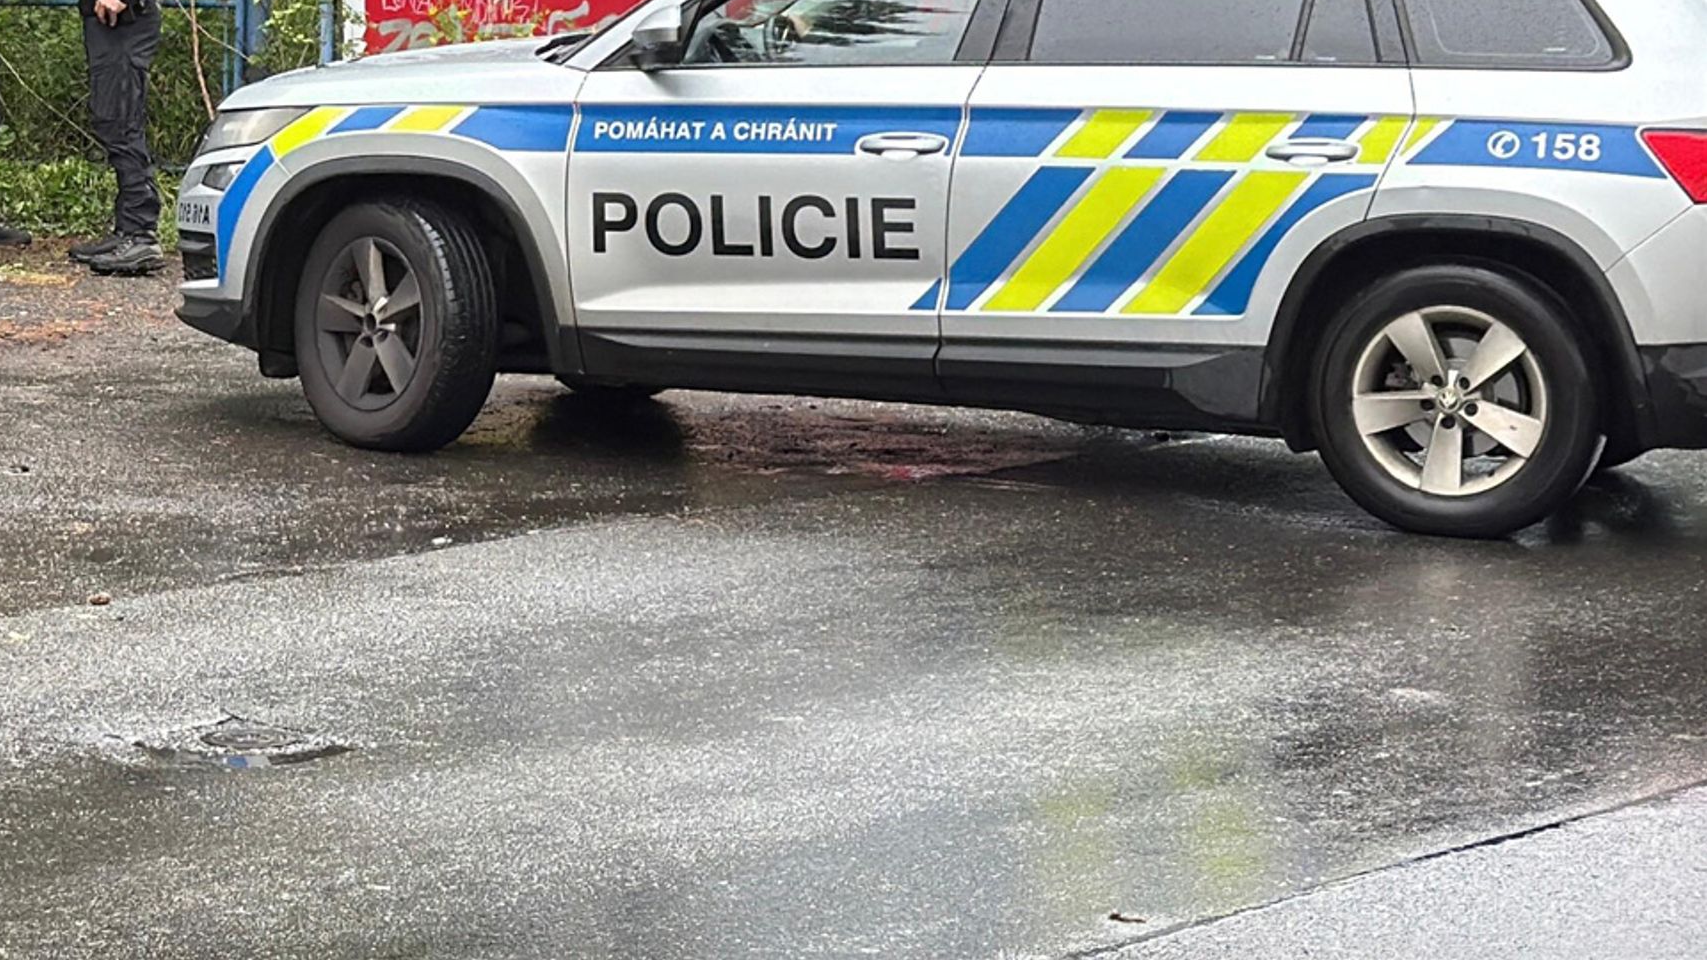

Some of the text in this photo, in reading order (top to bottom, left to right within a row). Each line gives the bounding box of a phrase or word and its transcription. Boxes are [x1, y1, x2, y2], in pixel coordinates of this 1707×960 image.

[593, 117, 838, 142] POMÁHAT A CHRÁNIT
[1529, 131, 1602, 162] 158
[591, 192, 921, 261] POLICIE
